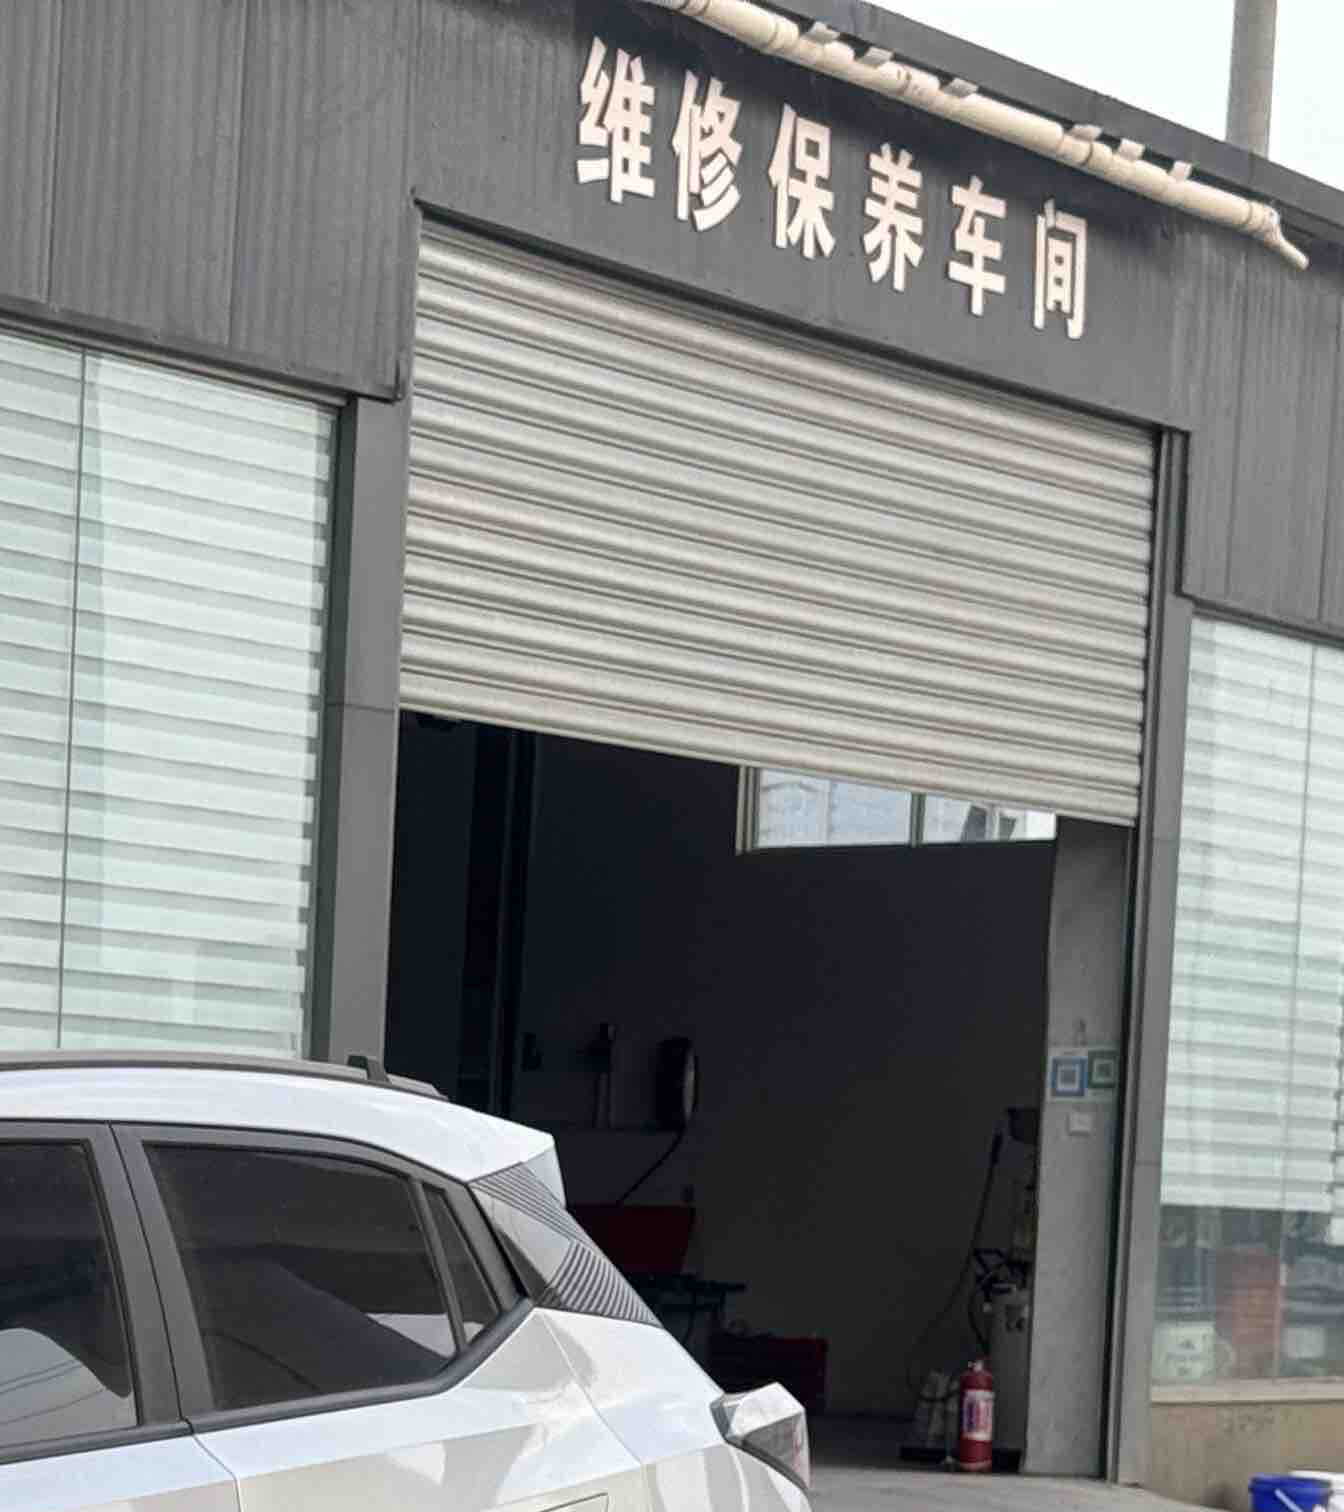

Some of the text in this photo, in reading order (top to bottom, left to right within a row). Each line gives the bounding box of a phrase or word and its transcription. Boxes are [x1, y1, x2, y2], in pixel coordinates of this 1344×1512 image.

[576, 36, 1089, 341] 维修保养车间
